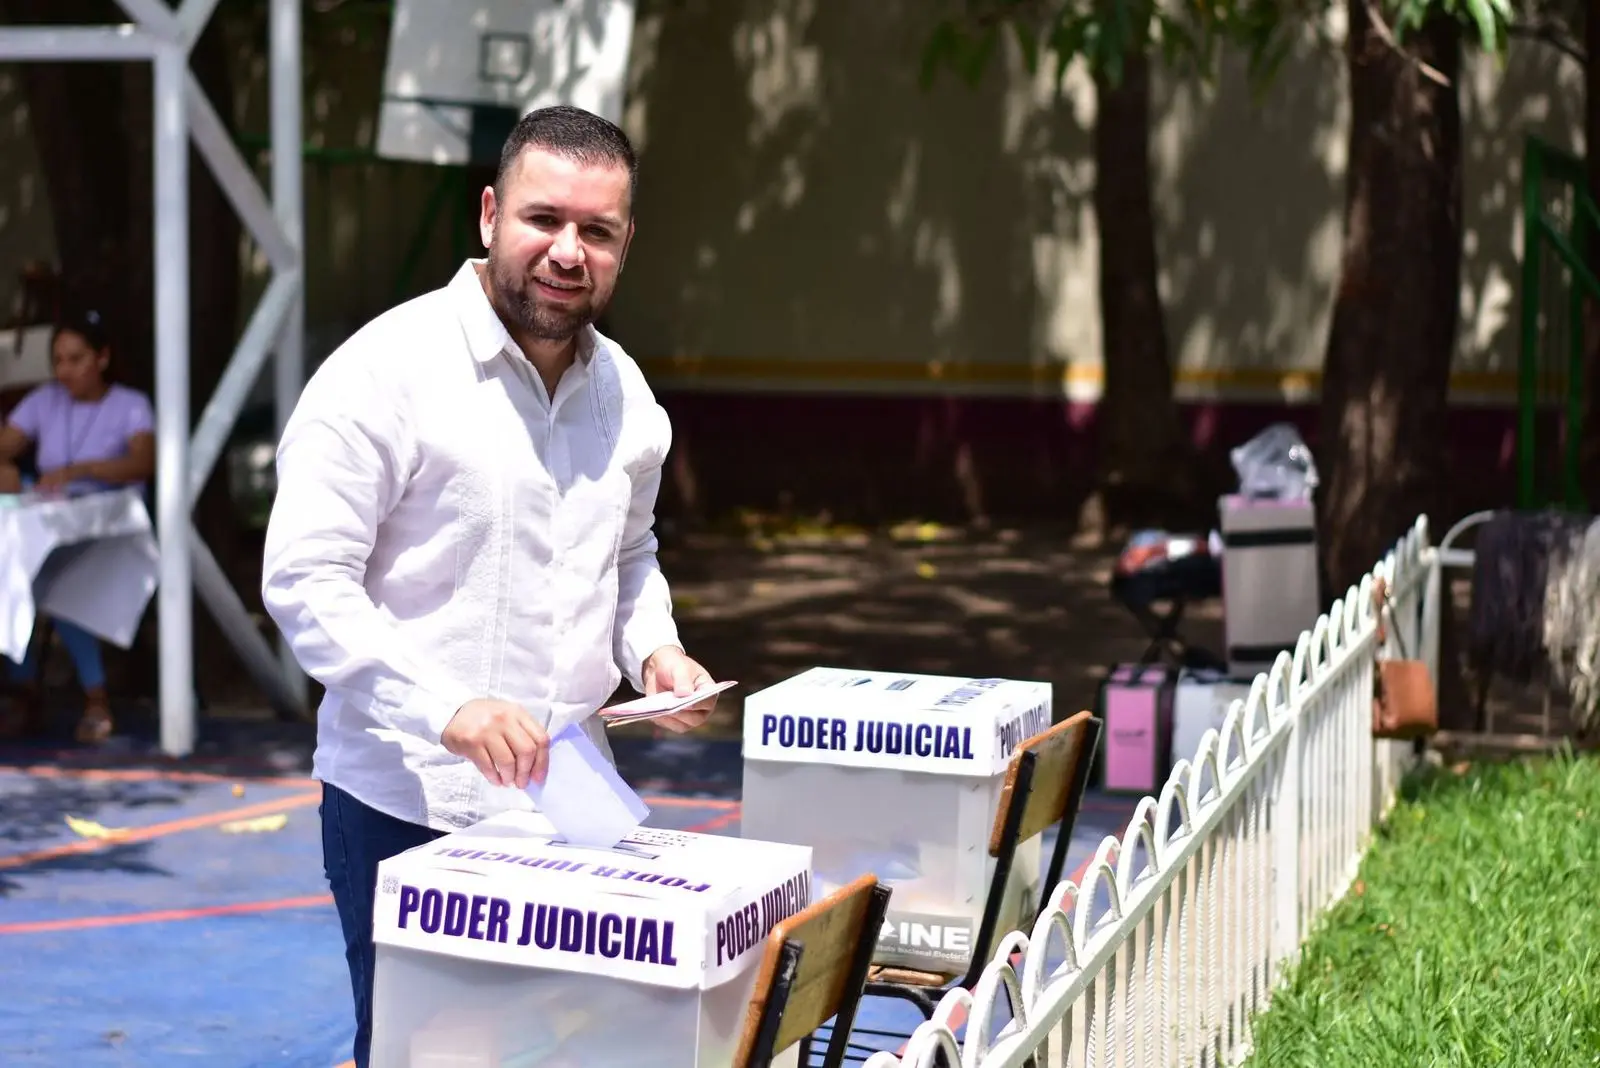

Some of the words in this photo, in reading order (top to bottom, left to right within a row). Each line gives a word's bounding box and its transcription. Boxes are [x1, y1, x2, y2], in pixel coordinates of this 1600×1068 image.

[761, 713, 847, 751] PODER
[853, 720, 974, 760] JUDICIAL
[433, 847, 592, 873] JUDICIAL
[590, 865, 712, 892] PODER
[398, 884, 511, 944] PODER
[517, 901, 678, 967] JUDICIAL
[716, 900, 760, 967] PODER
[899, 921, 970, 950] INE
